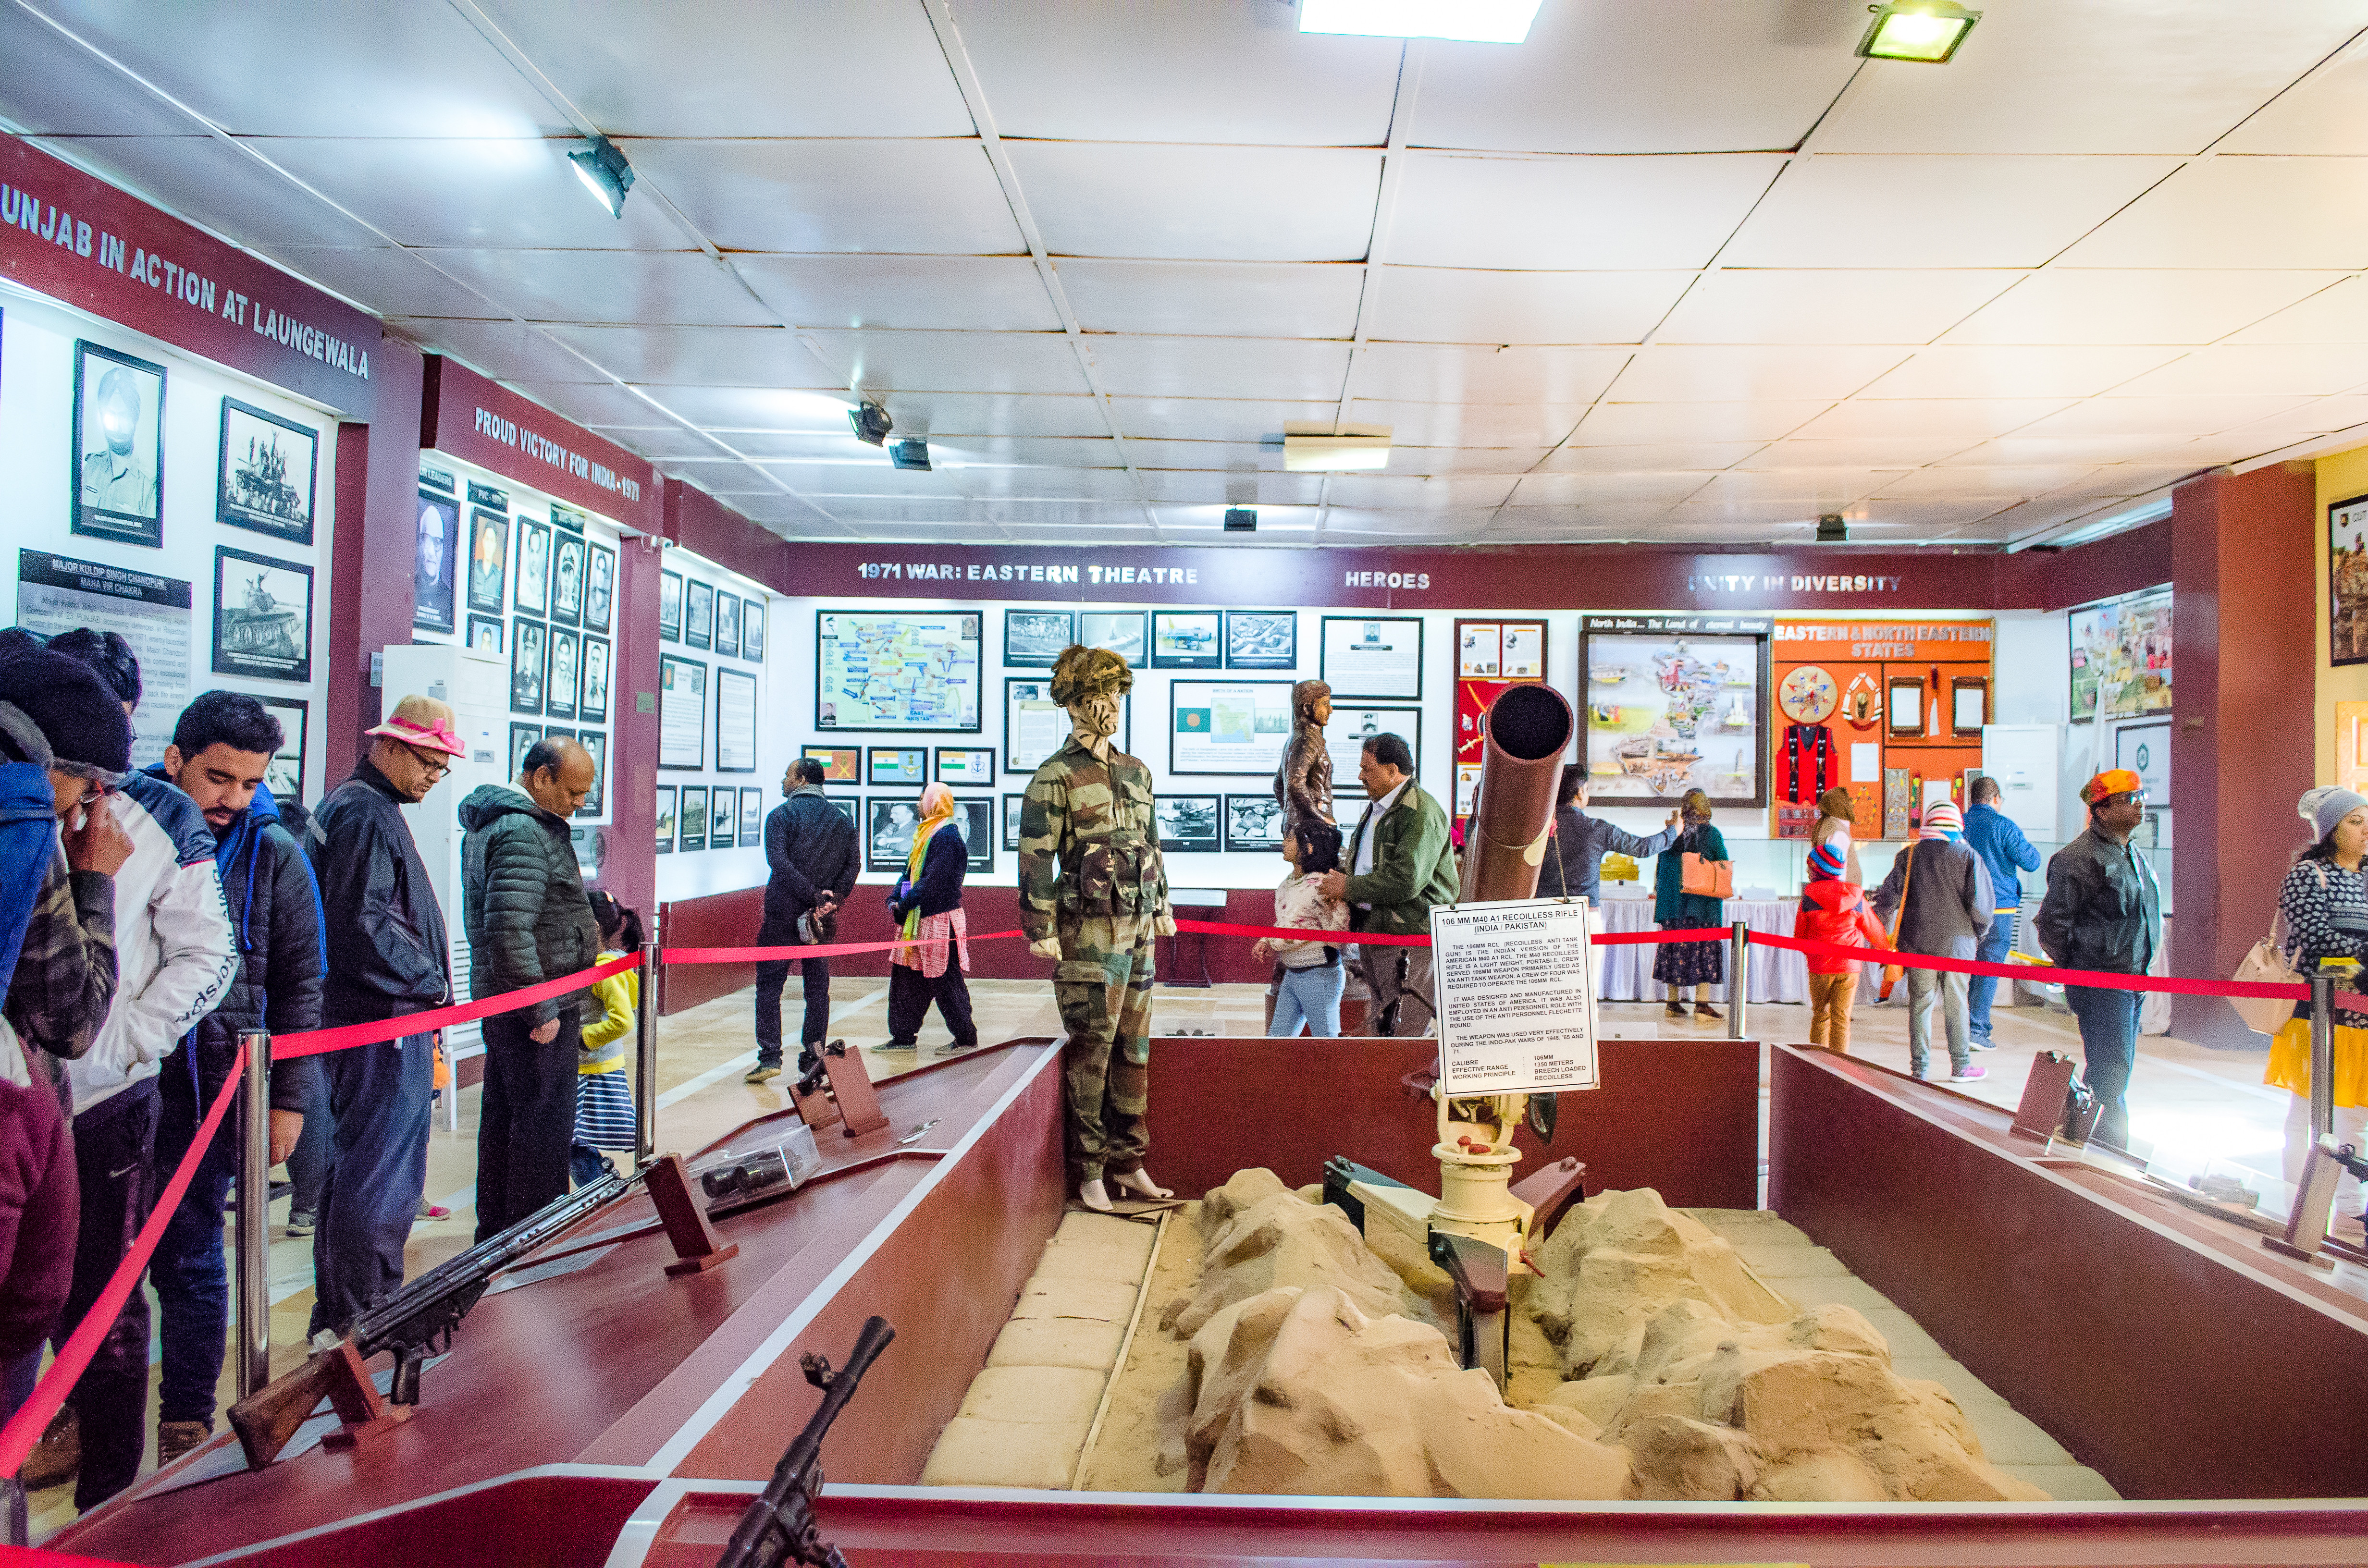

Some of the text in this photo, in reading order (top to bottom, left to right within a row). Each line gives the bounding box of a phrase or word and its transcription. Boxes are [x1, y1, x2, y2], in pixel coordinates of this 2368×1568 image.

[99, 231, 125, 273] IN
[130, 248, 215, 313] ACTION
[222, 289, 248, 326] AT
[254, 303, 369, 380] LAUNGEWALA
[475, 407, 516, 447] PROUD
[519, 427, 567, 470] VICTORY
[569, 452, 588, 480] FOR
[52, 559, 78, 573] MAJOR
[106, 568, 126, 581] SINGH
[858, 563, 1197, 584] 1971 WAR: EASTERN THEATRE
[80, 576, 142, 596] MAHA VIR CHAKRA
[1345, 571, 1430, 589] HEROES
[1764, 576, 1783, 591] IN
[1791, 575, 1901, 592] DIVERSITY
[1590, 619, 1613, 629] North
[1648, 619, 1663, 629] The
[1665, 619, 1686, 629] Land
[1689, 619, 1699, 629] of
[1774, 625, 1991, 642] EASTERN & NORTH EASTERN
[1851, 643, 1914, 658] STATES
[1502, 911, 1553, 921] RECOILLESS
[1555, 909, 1578, 918] RIFLE
[1474, 924, 1499, 934] (INDIA
[1505, 921, 1547, 930] PAKISTAN)
[1504, 939, 1542, 947] (RECOILLESS
[1525, 989, 1573, 997] MANUFACTURED
